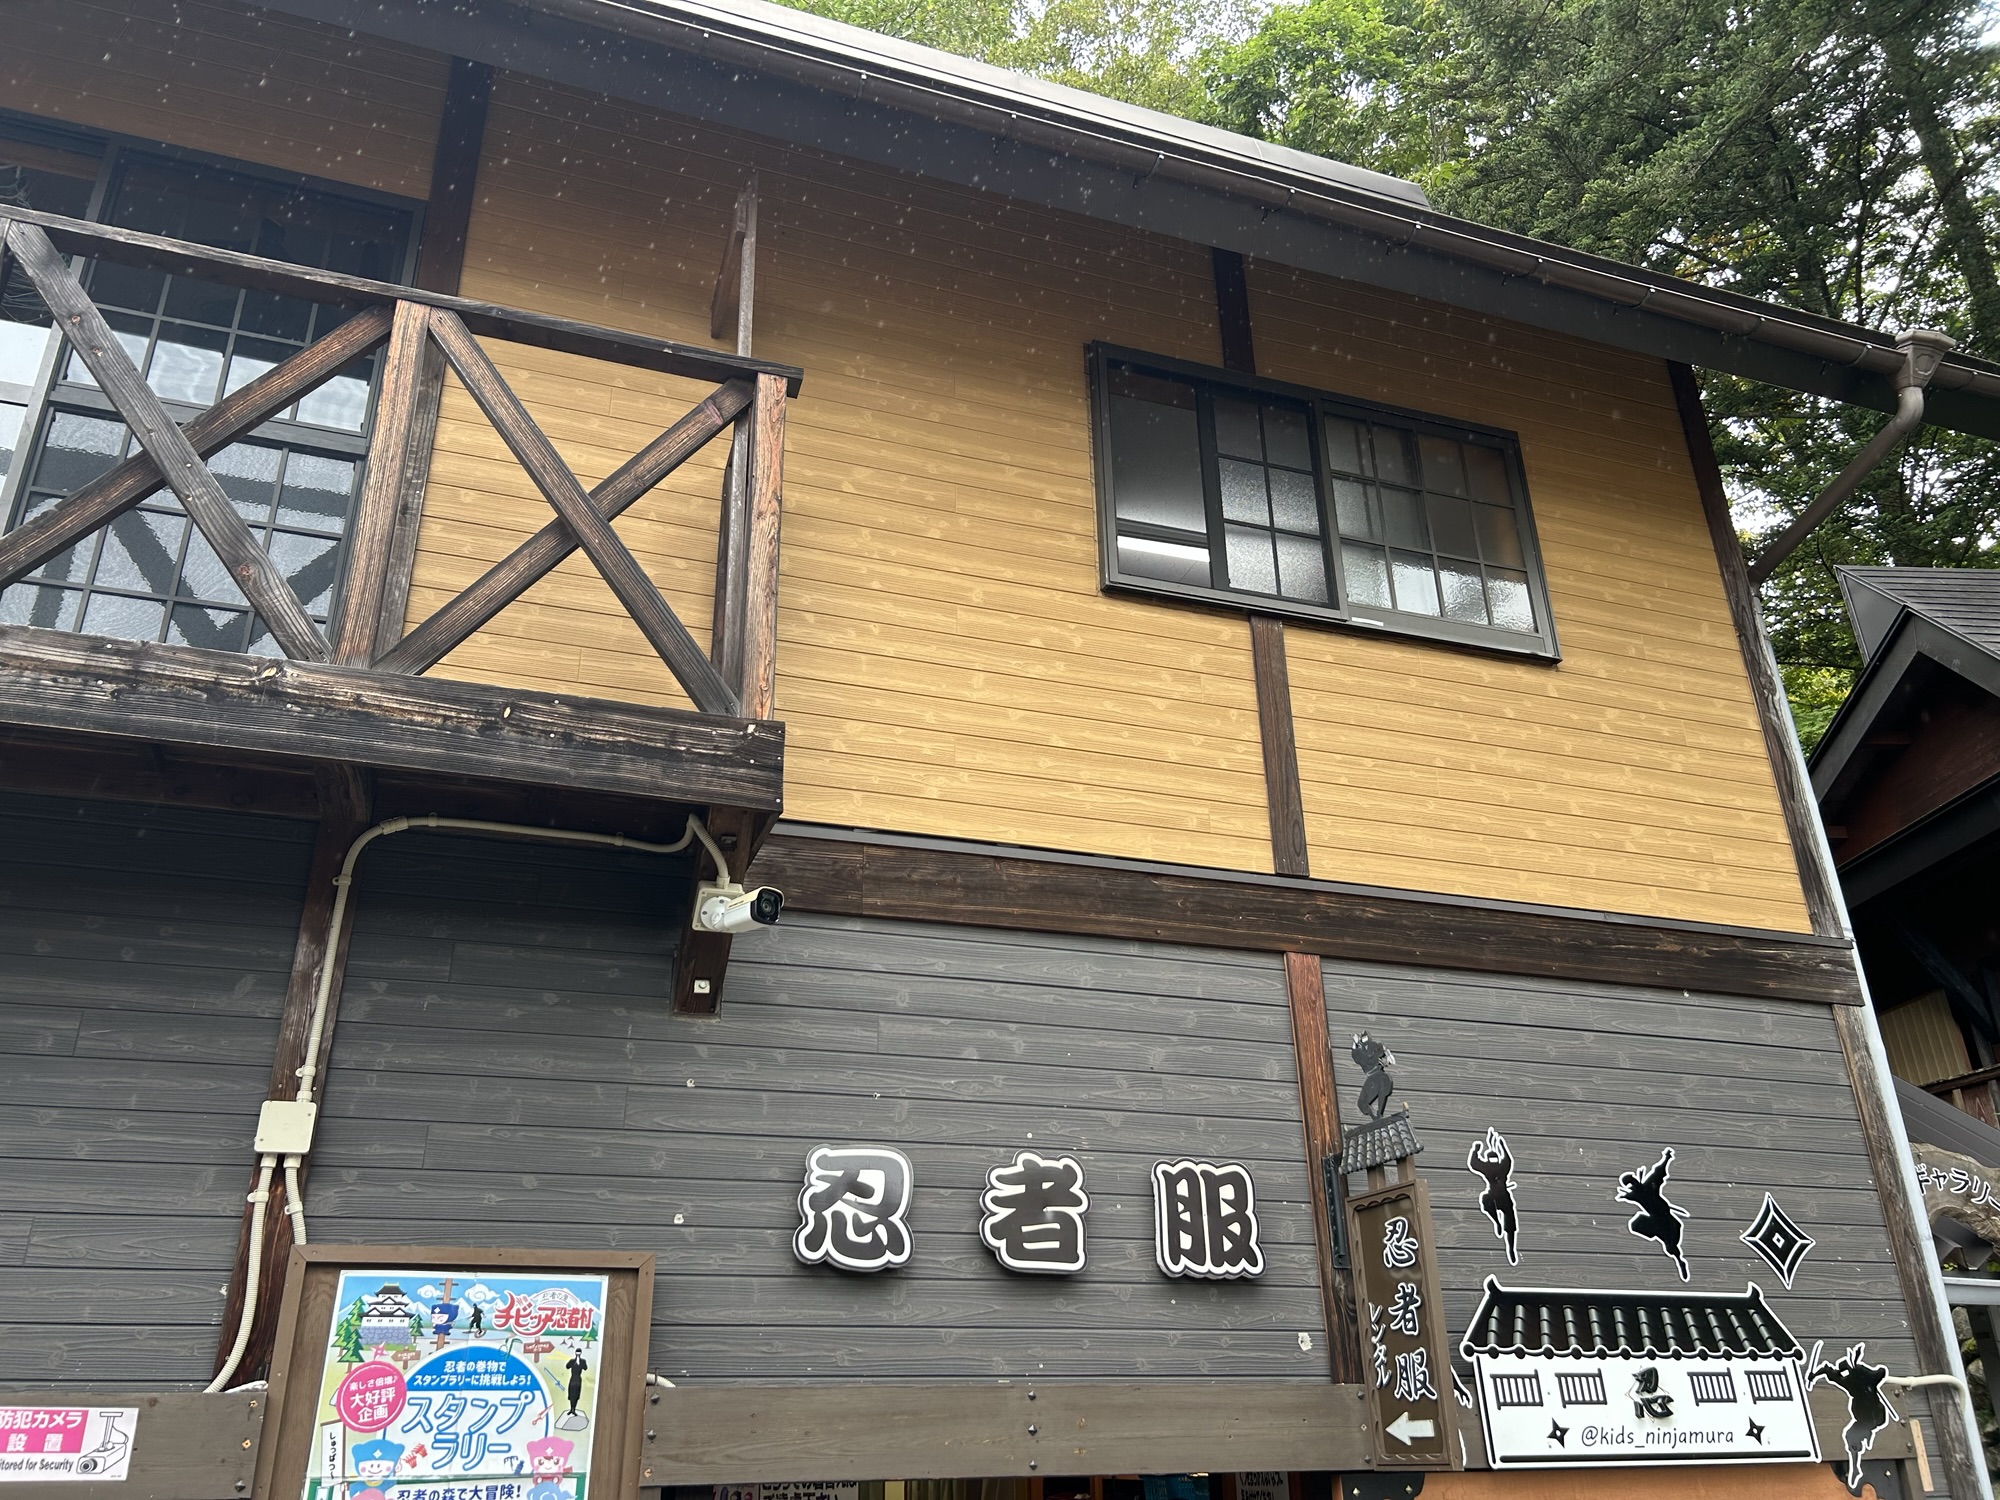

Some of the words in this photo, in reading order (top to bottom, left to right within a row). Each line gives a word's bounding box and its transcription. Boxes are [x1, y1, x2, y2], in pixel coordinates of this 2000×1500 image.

[793, 1144, 1266, 1278] 忍者服
[1383, 1216, 1437, 1401] 忍者服
[1368, 1302, 1391, 1388] レンタル
[444, 1361, 506, 1373] 忍者の巻物で
[350, 1387, 396, 1408] 大好評
[0, 1410, 82, 1429] 防犯カメラ
[358, 1404, 388, 1423] 企画
[402, 1391, 535, 1434] スタンプ
[6, 1433, 63, 1452] 設置
[1581, 1425, 1734, 1449] @kids_ninjamura
[432, 1431, 511, 1470] ラリー
[25, 1458, 38, 1470] for
[39, 1458, 74, 1473] Security
